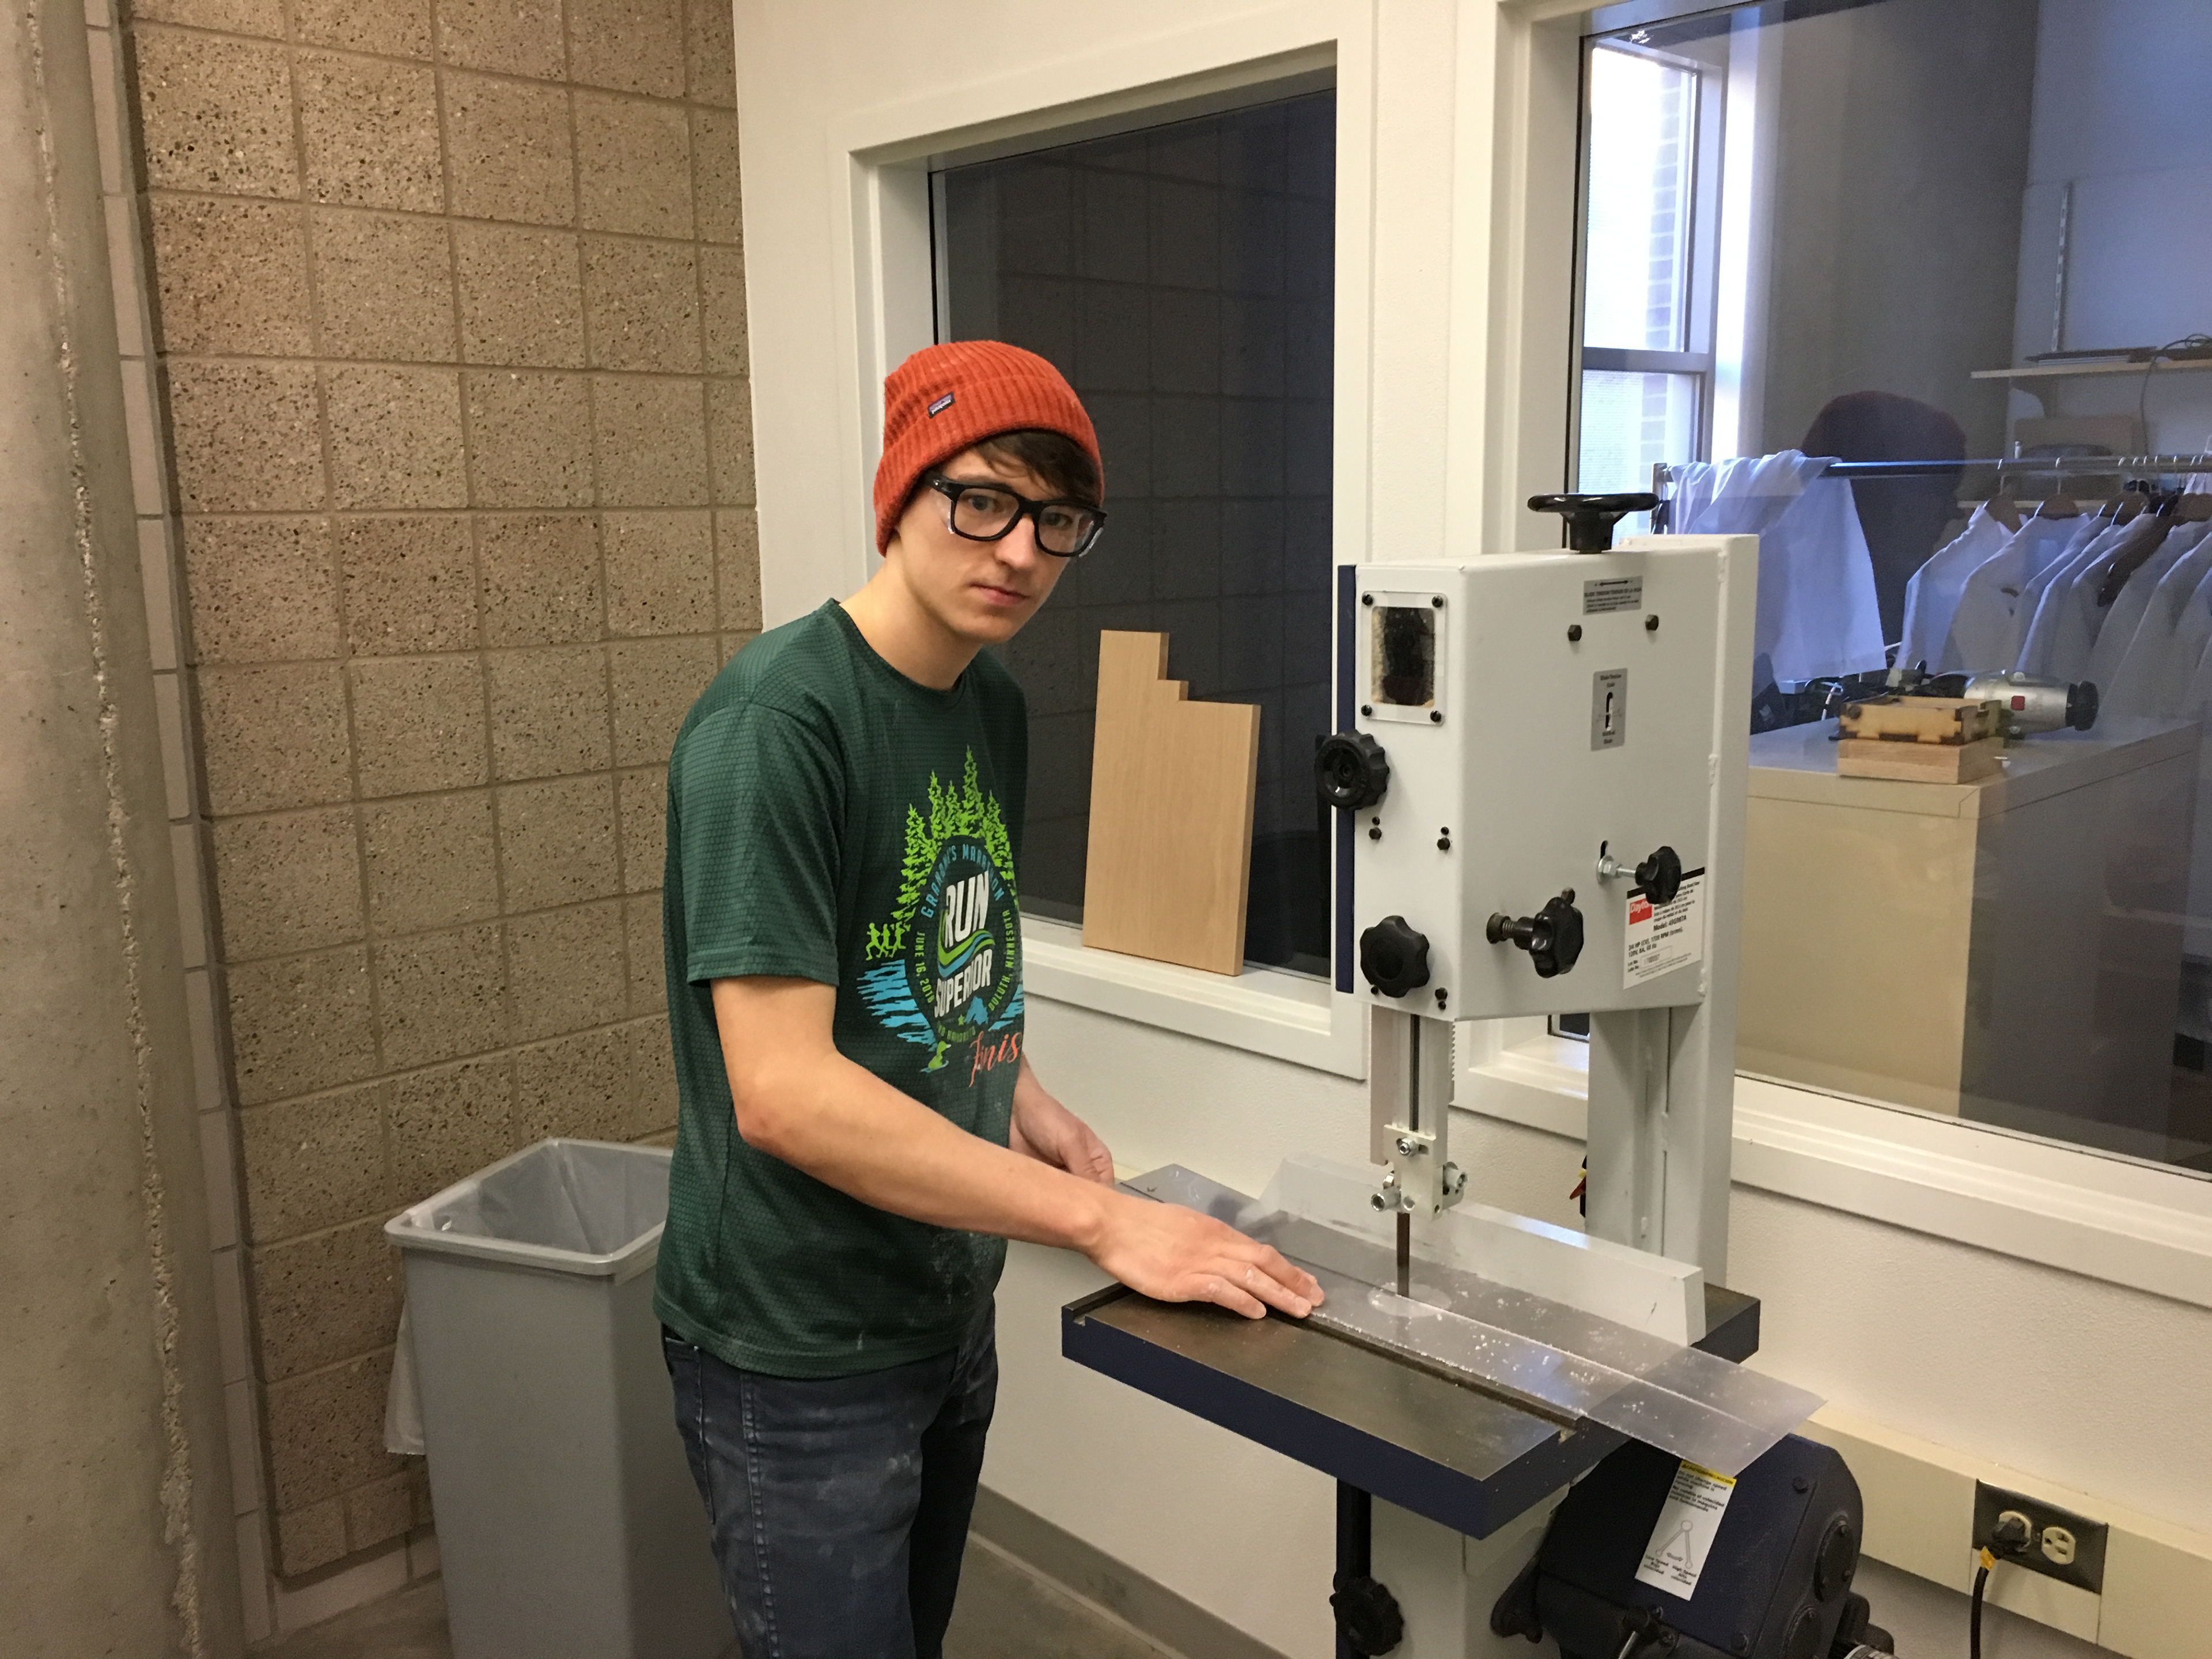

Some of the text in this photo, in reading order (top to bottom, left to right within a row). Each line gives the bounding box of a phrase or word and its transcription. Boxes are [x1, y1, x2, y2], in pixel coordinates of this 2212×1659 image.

[945, 870, 989, 948] RUN
[1630, 899, 1652, 914] Dayto
[915, 931, 925, 957] JUNE
[1002, 910, 1015, 968] MINNESOTA
[934, 949, 993, 1018] SUPERIOR
